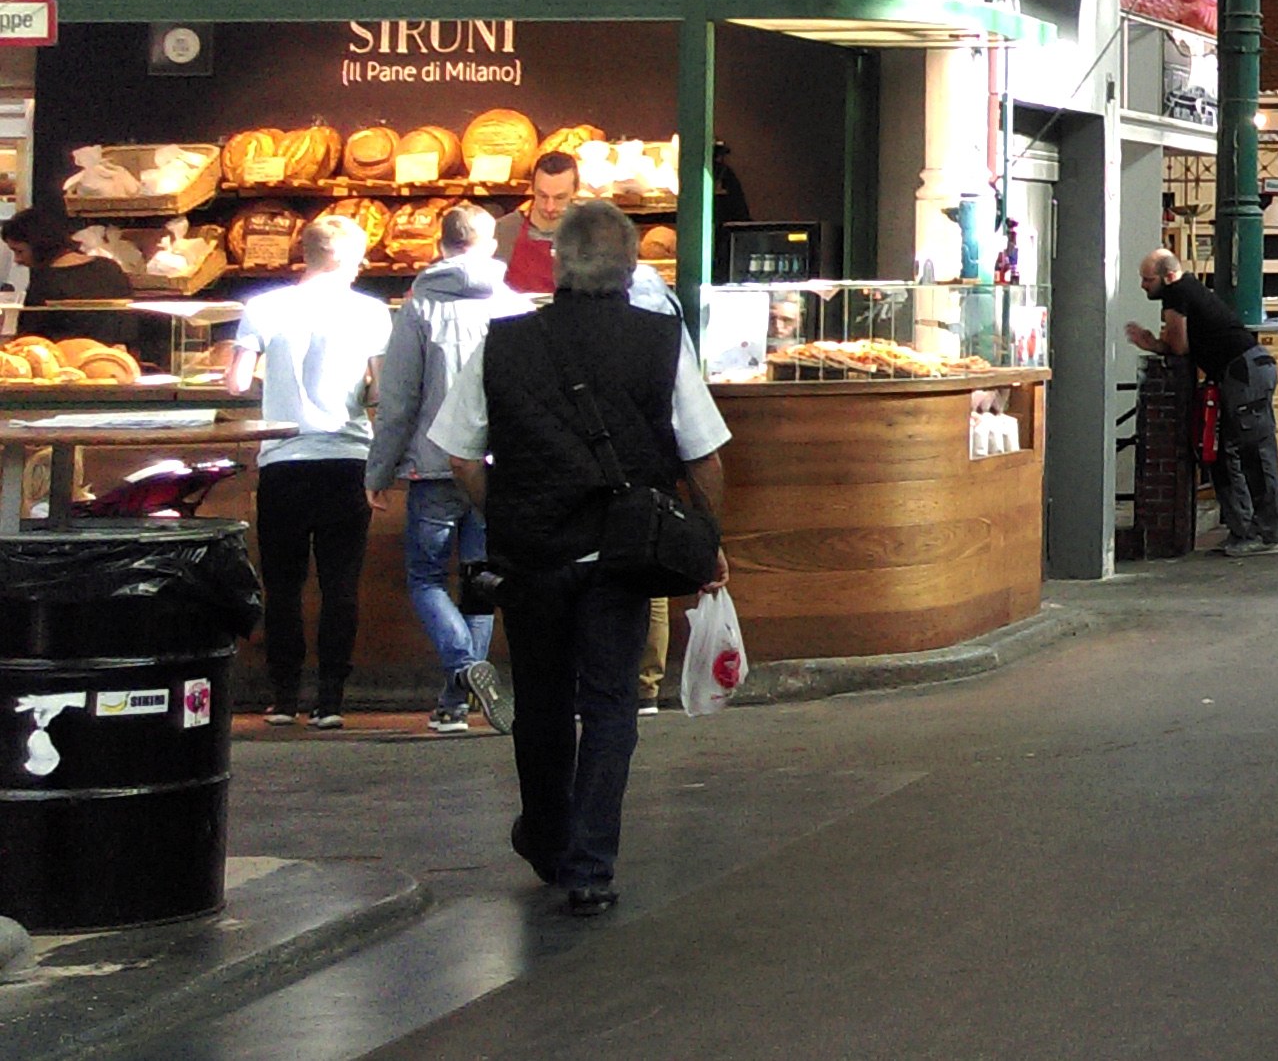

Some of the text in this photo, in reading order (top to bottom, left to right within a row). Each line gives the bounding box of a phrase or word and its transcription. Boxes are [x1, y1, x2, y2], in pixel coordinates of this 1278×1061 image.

[348, 19, 517, 54] SIRUNI
[366, 60, 417, 82] Pane
[421, 61, 440, 82] di
